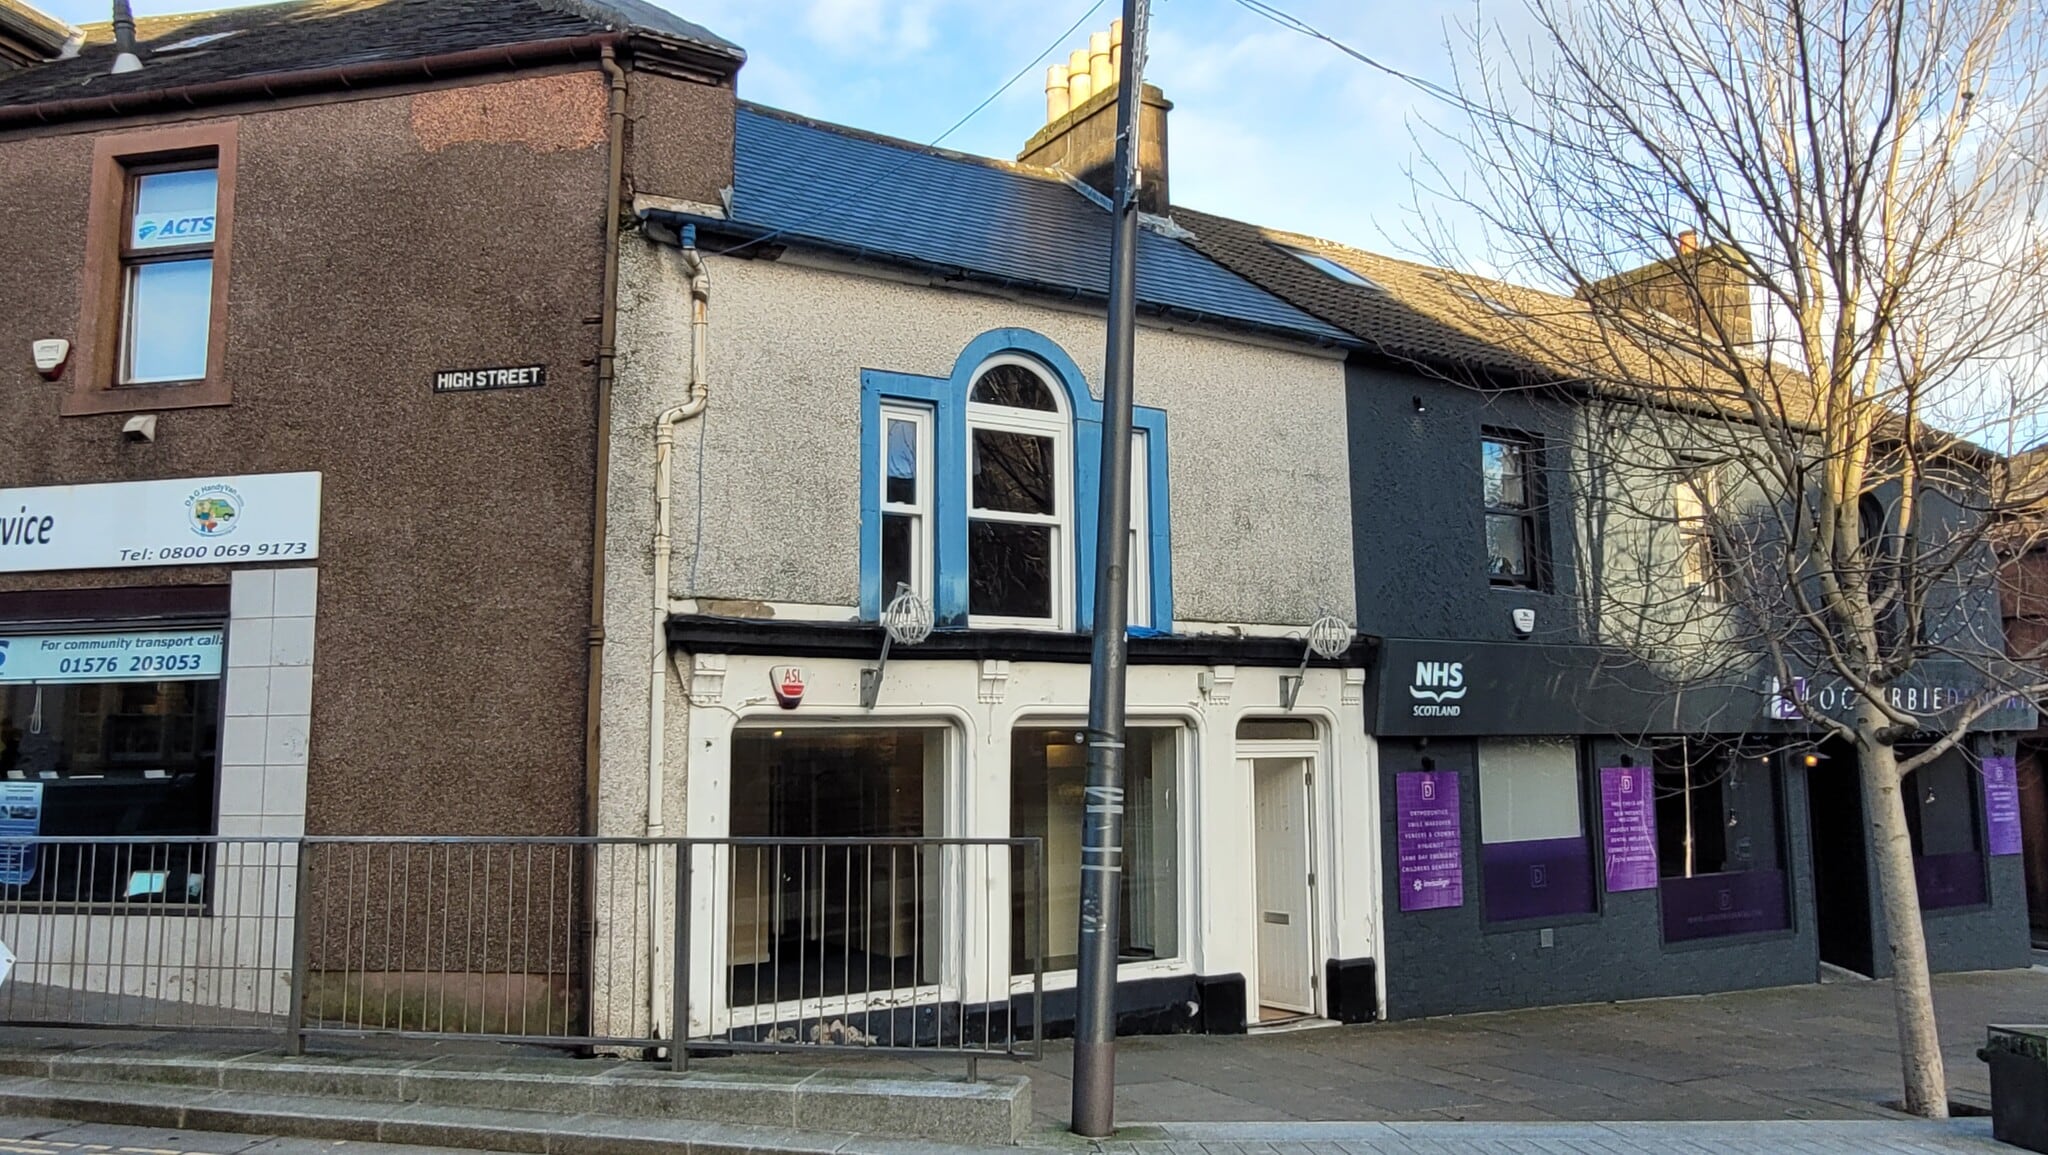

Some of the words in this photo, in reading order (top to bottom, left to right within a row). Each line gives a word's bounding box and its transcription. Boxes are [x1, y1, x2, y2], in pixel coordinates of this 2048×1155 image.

[159, 216, 215, 235] ACTS
[437, 371, 474, 389] HIGH
[476, 367, 541, 387] STREET
[0, 505, 54, 545] vice
[120, 549, 153, 561] Tel:
[159, 546, 207, 560] 0800
[214, 544, 251, 557] 069
[256, 542, 307, 556] 9173
[41, 640, 62, 650] For
[64, 637, 132, 651] community
[136, 636, 194, 650] transport
[59, 657, 118, 674] 01576
[129, 654, 202, 672] 203053
[784, 668, 803, 683] ASL
[1416, 661, 1463, 687] NHS
[1413, 705, 1461, 717] SCOTLAND
